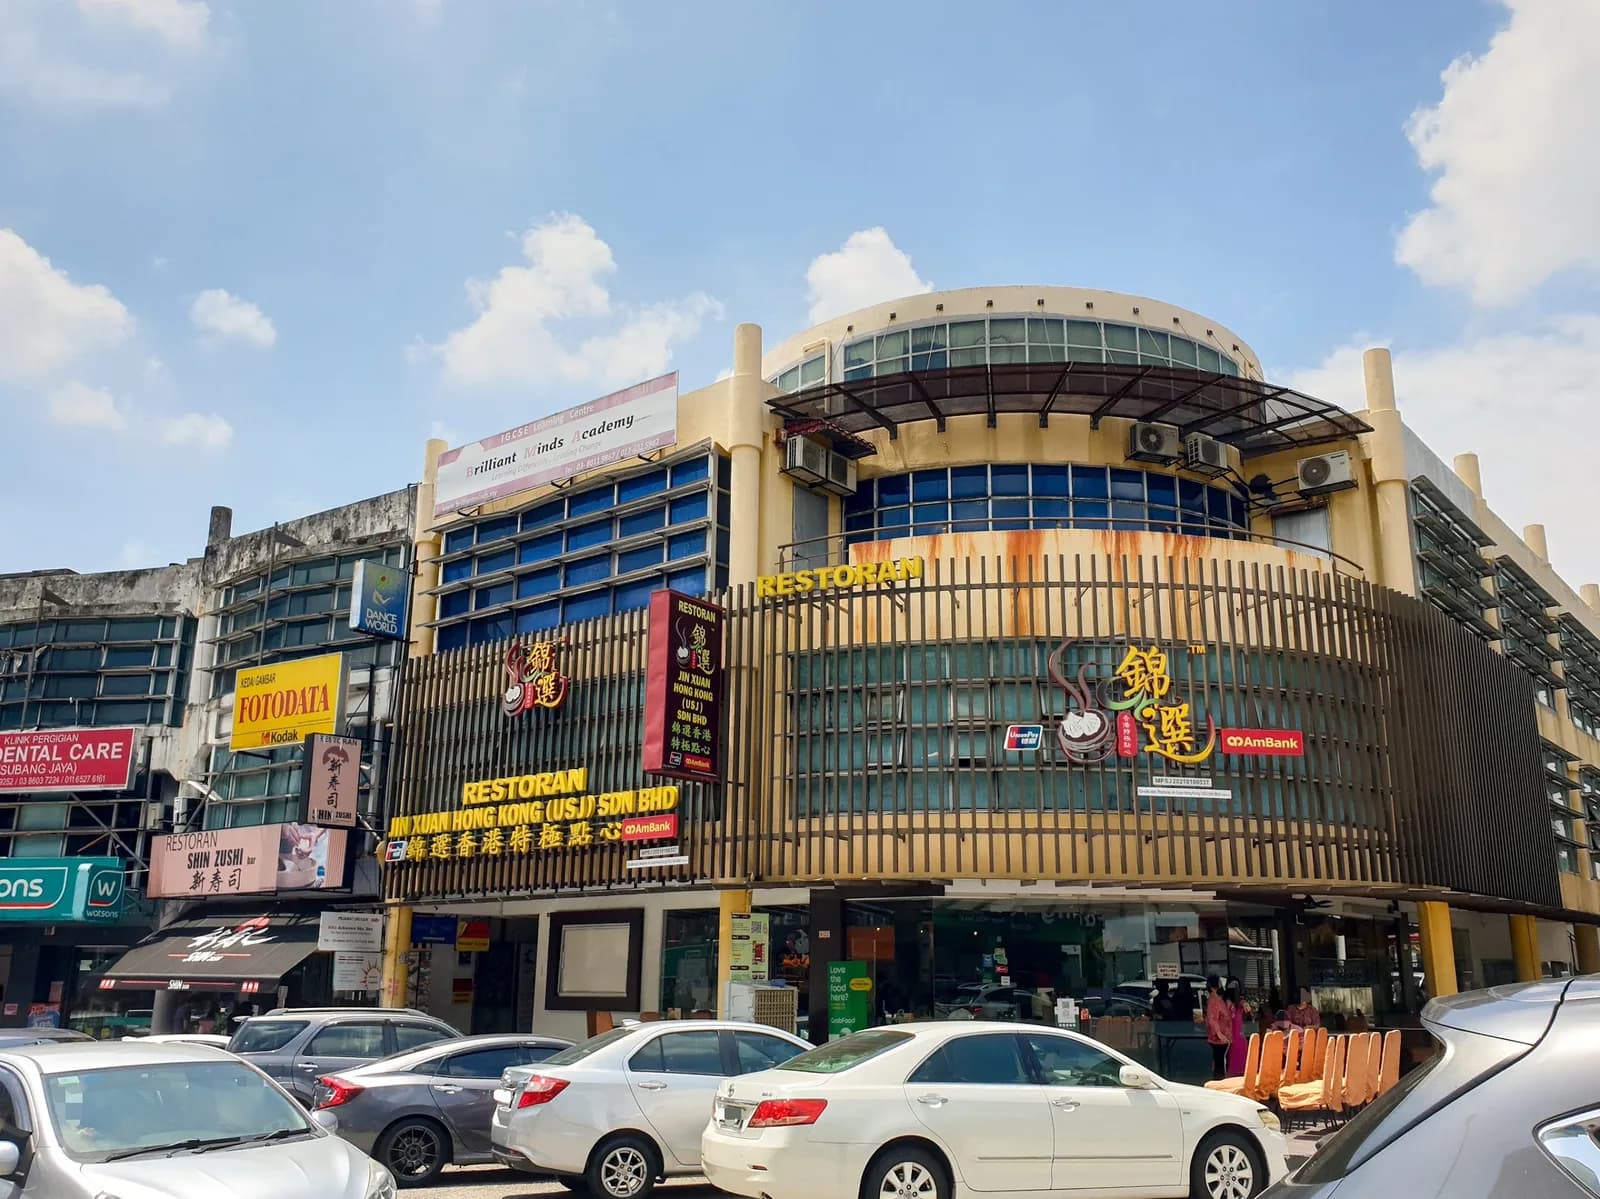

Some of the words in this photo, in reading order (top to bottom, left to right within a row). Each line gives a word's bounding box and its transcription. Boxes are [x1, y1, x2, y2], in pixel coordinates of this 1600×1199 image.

[500, 425, 531, 444] IGCSE
[466, 451, 517, 478] Brilliant
[524, 437, 565, 459] Minds
[571, 415, 635, 444] Academy
[756, 556, 923, 598] RESTORAN
[367, 607, 397, 622] DANCE
[678, 600, 716, 623] RESTORAN
[366, 618, 398, 634] WORLD
[1188, 645, 1206, 655] TM
[678, 671, 690, 684] JIN
[691, 673, 710, 688] XUAN
[673, 682, 693, 695] HONG
[694, 687, 713, 702] KONG
[239, 684, 330, 724] FOTODATA
[682, 699, 703, 713] (USJ)
[677, 710, 691, 724] SDN
[692, 713, 707, 726] BHD
[4, 736, 30, 746] KLINIK
[32, 734, 79, 745] PERGIGIAN
[271, 729, 298, 744] Kodak
[1244, 737, 1298, 750] AmBank
[69, 742, 123, 760] CARE
[49, 762, 77, 775] JAYA)
[462, 768, 588, 806] RESTORAN
[388, 816, 411, 838] JIN
[411, 811, 453, 835] XUAN
[453, 806, 496, 831] HONG
[497, 801, 545, 826] KONG
[546, 796, 596, 822] (USJ)
[597, 790, 636, 817] SDN
[638, 785, 679, 812] BHD
[635, 822, 671, 835] AmBank
[165, 831, 218, 853] RESTORAN
[187, 850, 209, 870] SHIN
[214, 847, 243, 866] ZUSHI
[86, 909, 119, 919] watsons
[830, 966, 846, 974] Love
[831, 984, 847, 992] food
